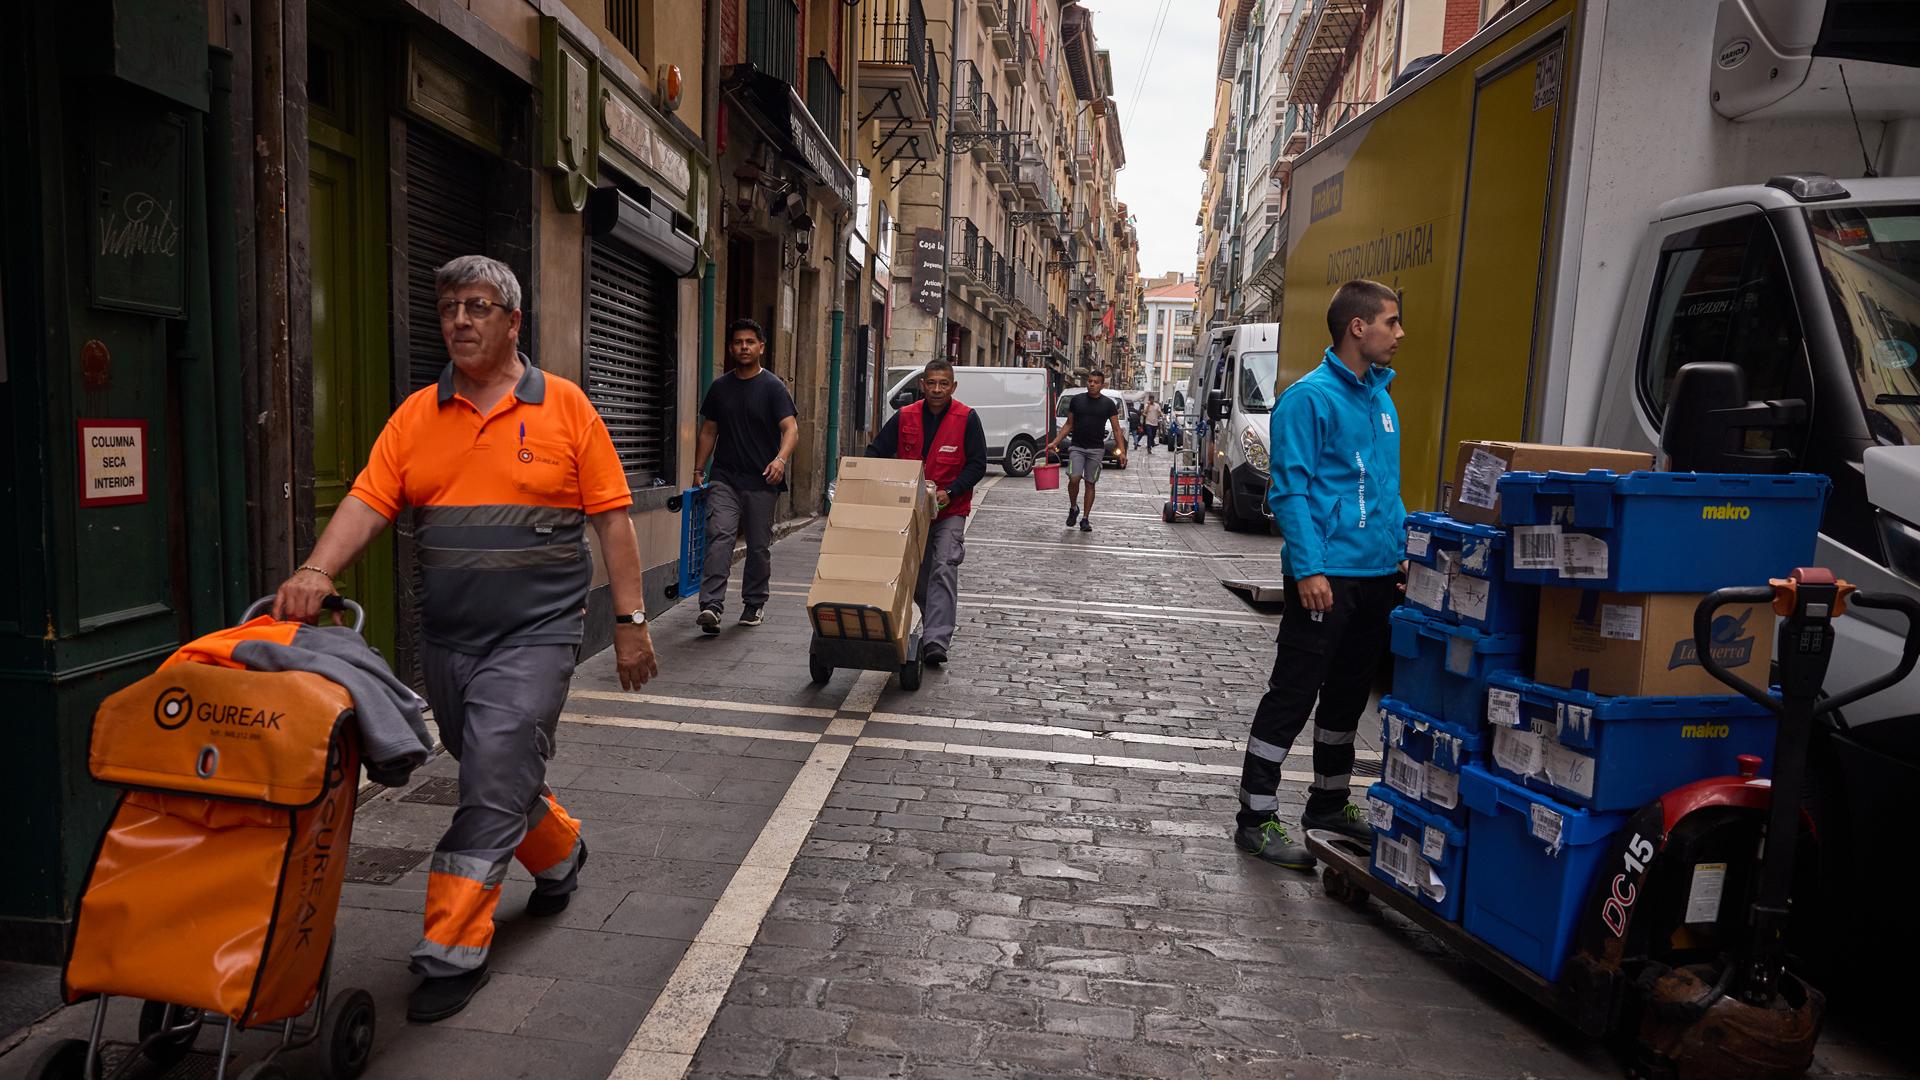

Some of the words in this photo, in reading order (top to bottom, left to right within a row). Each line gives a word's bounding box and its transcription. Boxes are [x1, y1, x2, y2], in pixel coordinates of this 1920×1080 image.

[919, 240, 936, 250] Casa
[1326, 228, 1392, 287] DISTRIBUCIÓN
[1393, 223, 1433, 271] DIARIA
[91, 436, 135, 448] COLUMNA
[102, 456, 127, 469] SECA
[94, 476, 135, 489] INTERIOR
[1358, 484, 1367, 521] transporte
[1702, 501, 1750, 520] makro
[1709, 646, 1745, 659] uerva
[197, 702, 286, 730] GUREAK
[1681, 722, 1729, 738] makro
[1602, 873, 1636, 938] DC
[1623, 832, 1654, 874] 15
